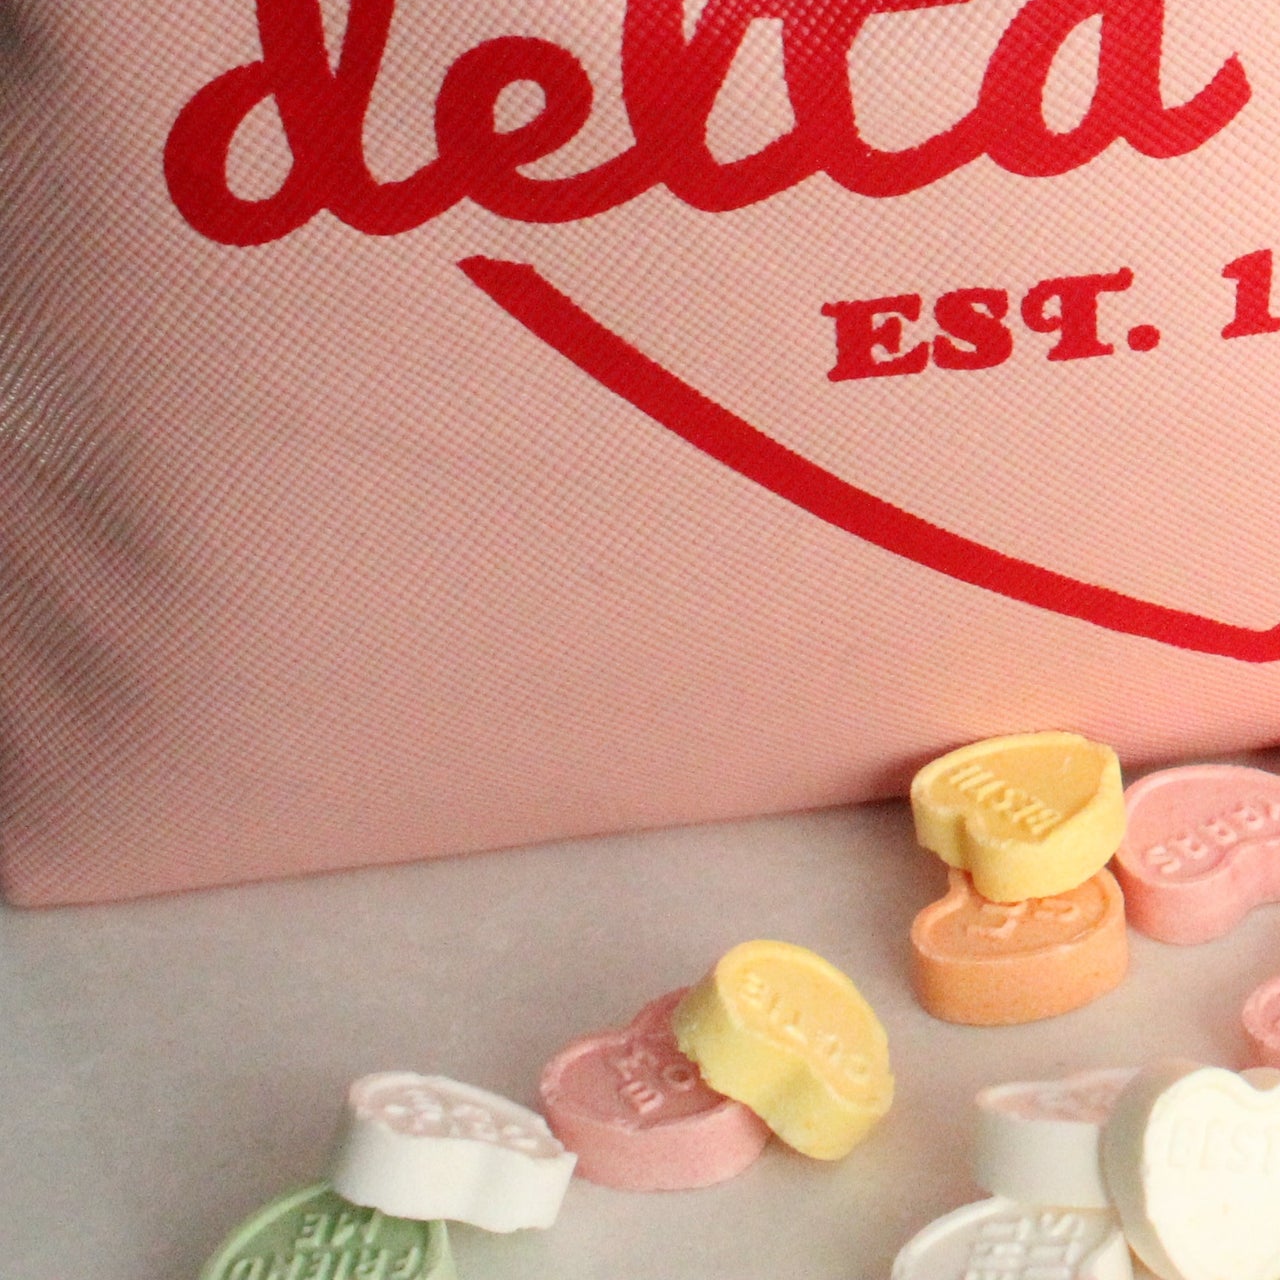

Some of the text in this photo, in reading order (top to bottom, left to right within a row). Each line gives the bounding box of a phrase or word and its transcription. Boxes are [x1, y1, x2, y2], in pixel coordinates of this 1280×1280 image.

[820, 267, 1161, 383] EST.
[946, 762, 1063, 836] BESTIE
[296, 1209, 384, 1247] ME
